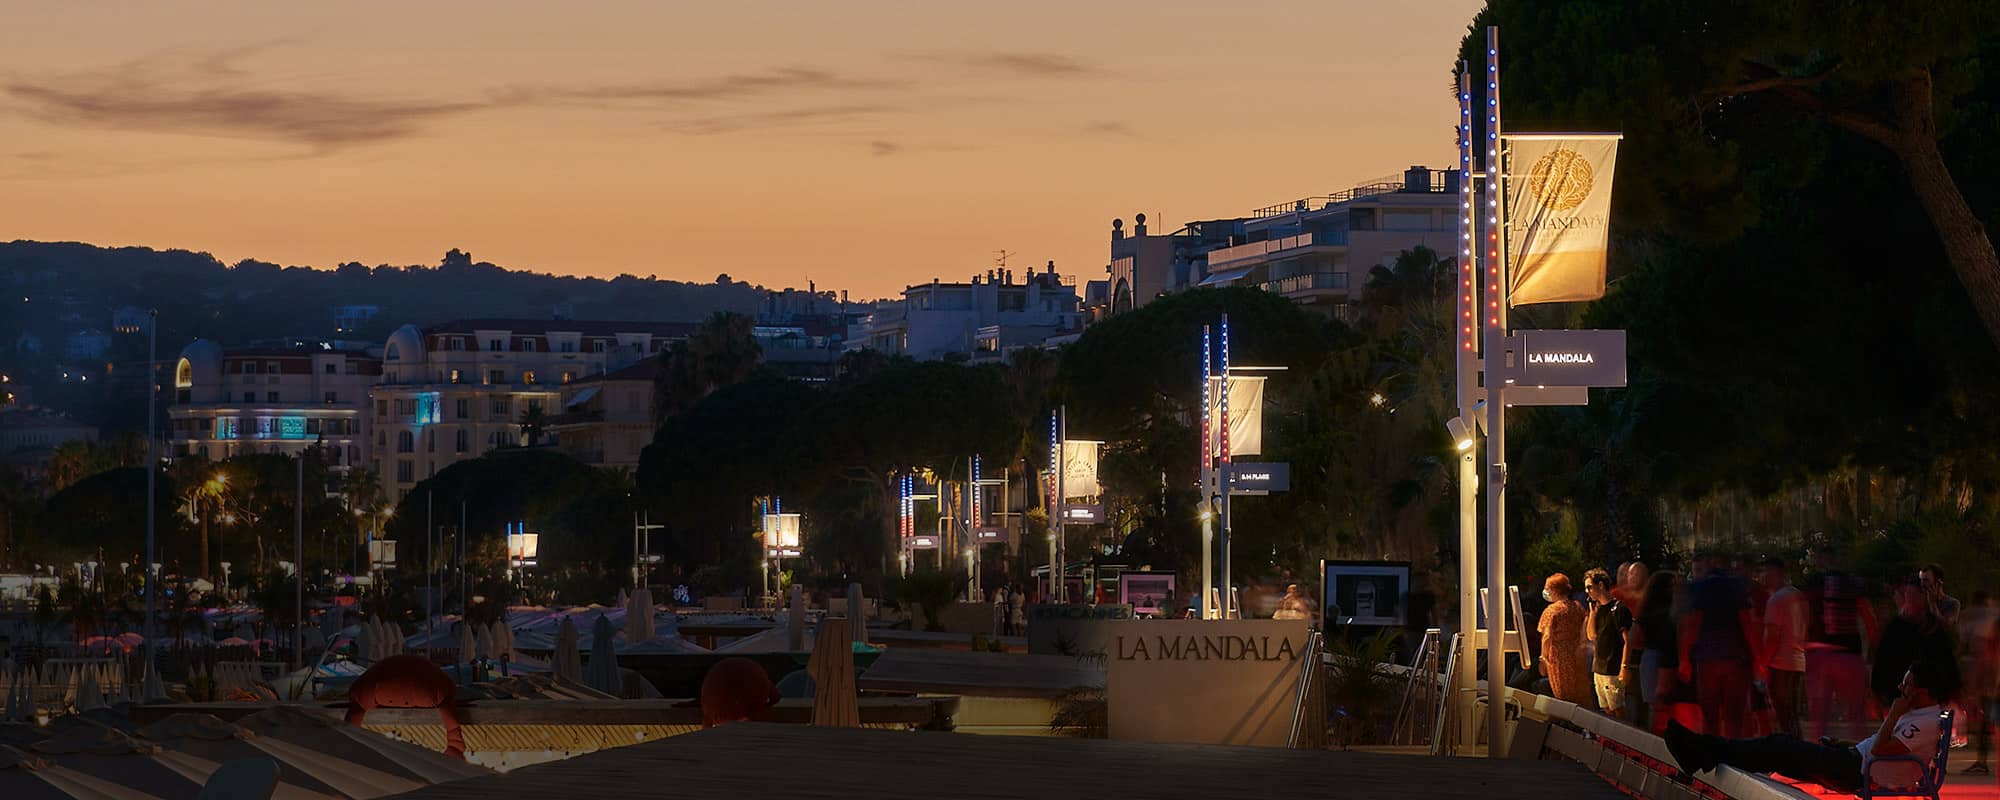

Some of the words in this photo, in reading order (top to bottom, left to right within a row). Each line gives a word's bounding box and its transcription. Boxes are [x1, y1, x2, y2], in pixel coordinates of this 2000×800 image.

[1513, 218, 1530, 232] LA
[1529, 353, 1543, 363] LA
[1544, 353, 1593, 363] MANDALA
[1117, 635, 1152, 661] LA
[1157, 634, 1297, 661] MANDALA
